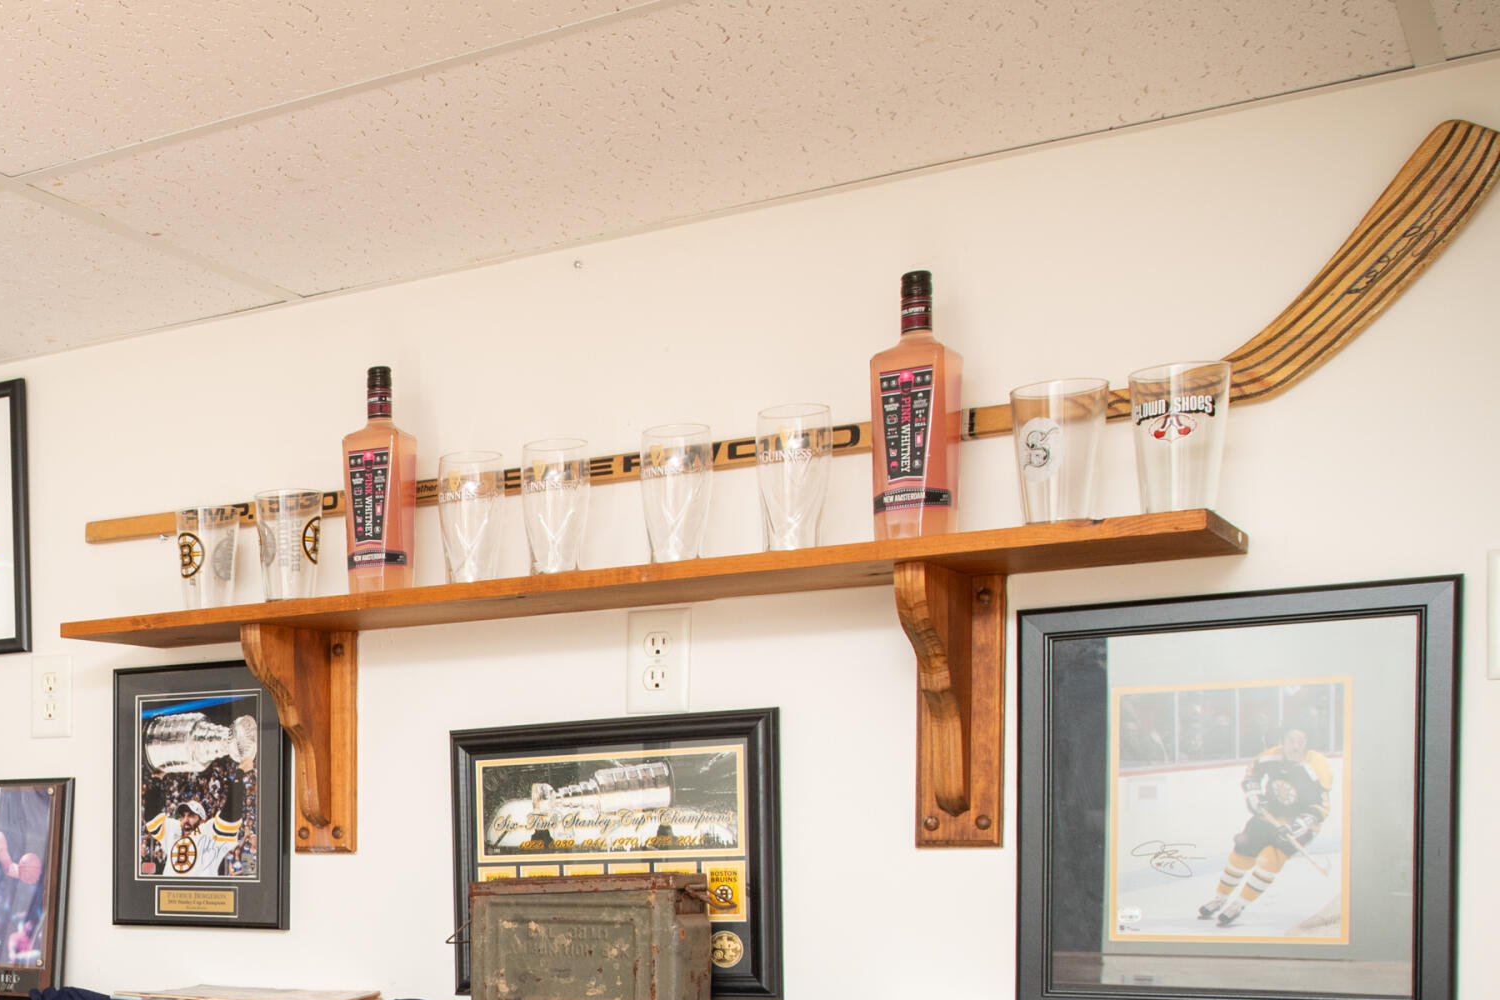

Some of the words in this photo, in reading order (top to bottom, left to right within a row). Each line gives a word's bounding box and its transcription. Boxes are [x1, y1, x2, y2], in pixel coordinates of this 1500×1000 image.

[901, 396, 911, 423] PINK
[1171, 394, 1213, 414] SHOES
[901, 423, 911, 472] WHITNEY
[365, 473, 373, 495] PINK
[365, 495, 373, 537] WHITNEY
[493, 811, 558, 832] Six-Time
[562, 811, 613, 833] Stanley
[617, 808, 647, 832] Cup
[657, 806, 734, 831] Champions
